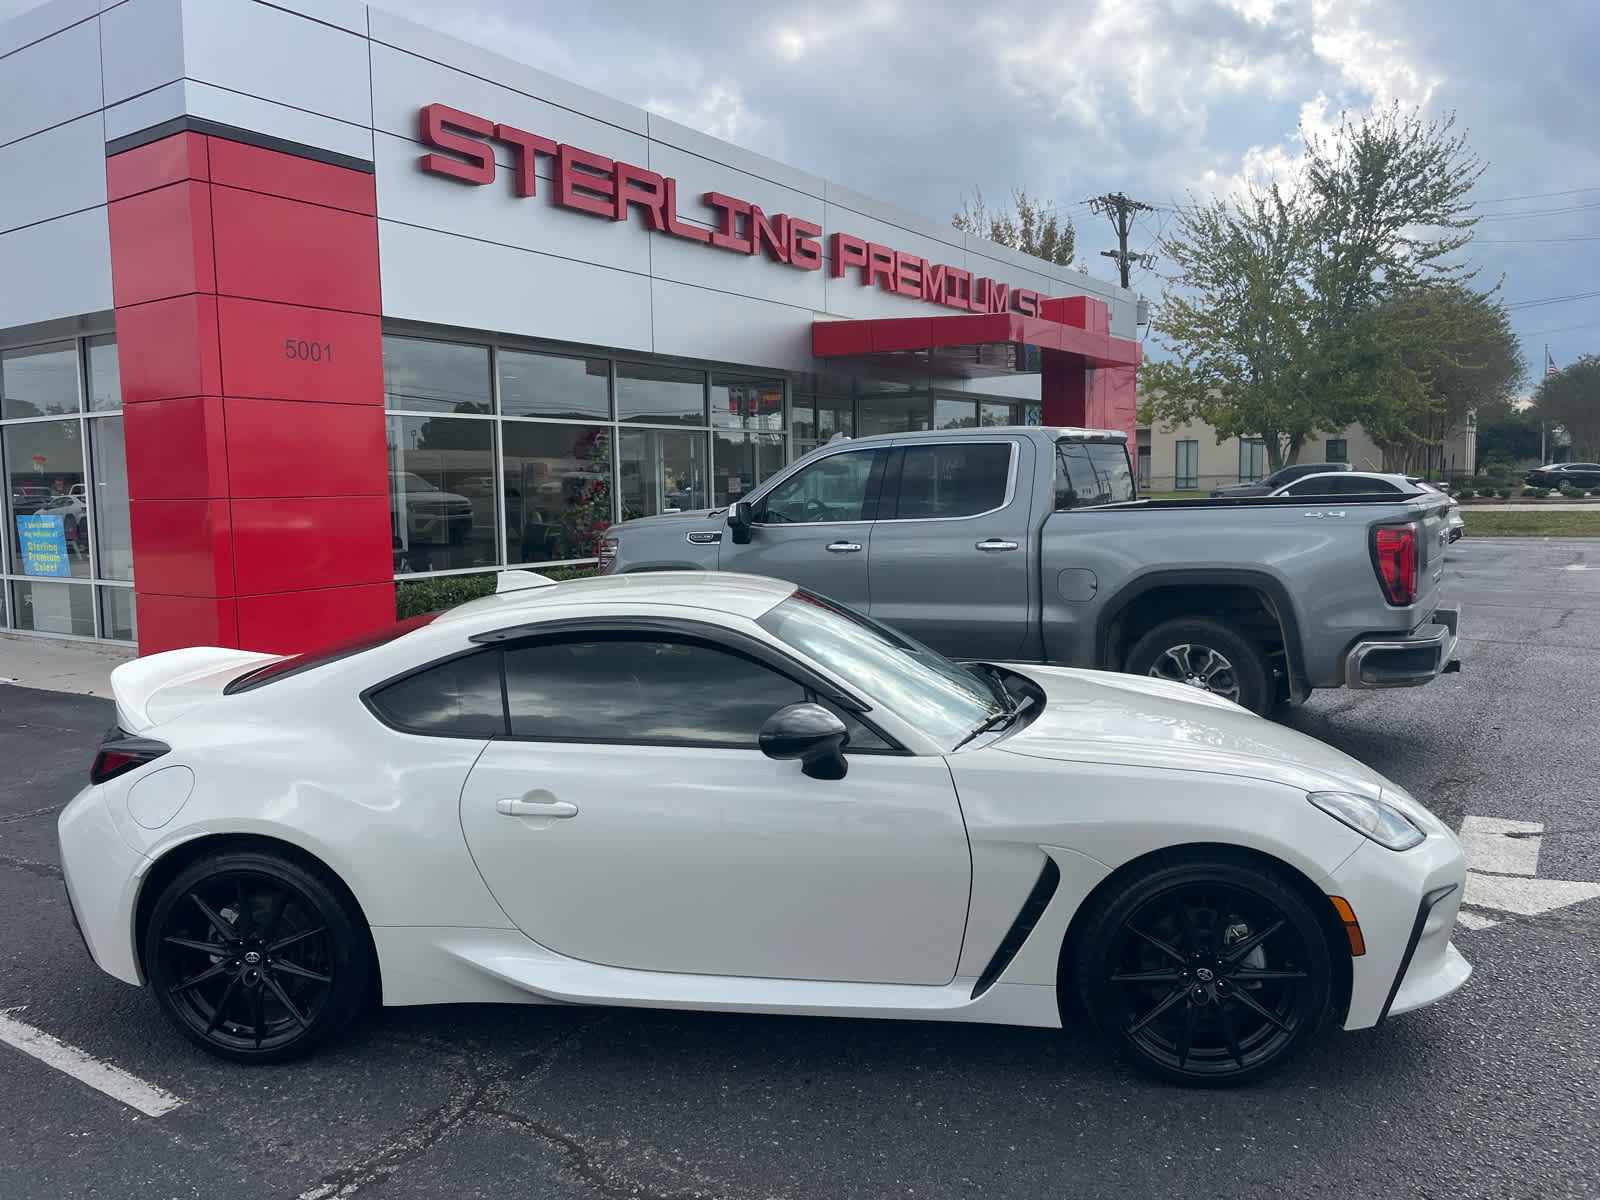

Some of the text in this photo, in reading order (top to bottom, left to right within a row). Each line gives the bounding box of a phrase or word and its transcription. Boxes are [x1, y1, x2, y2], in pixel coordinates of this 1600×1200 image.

[419, 103, 822, 271] STERLING
[830, 232, 1010, 313] PREMIUM
[285, 339, 331, 363] 5001
